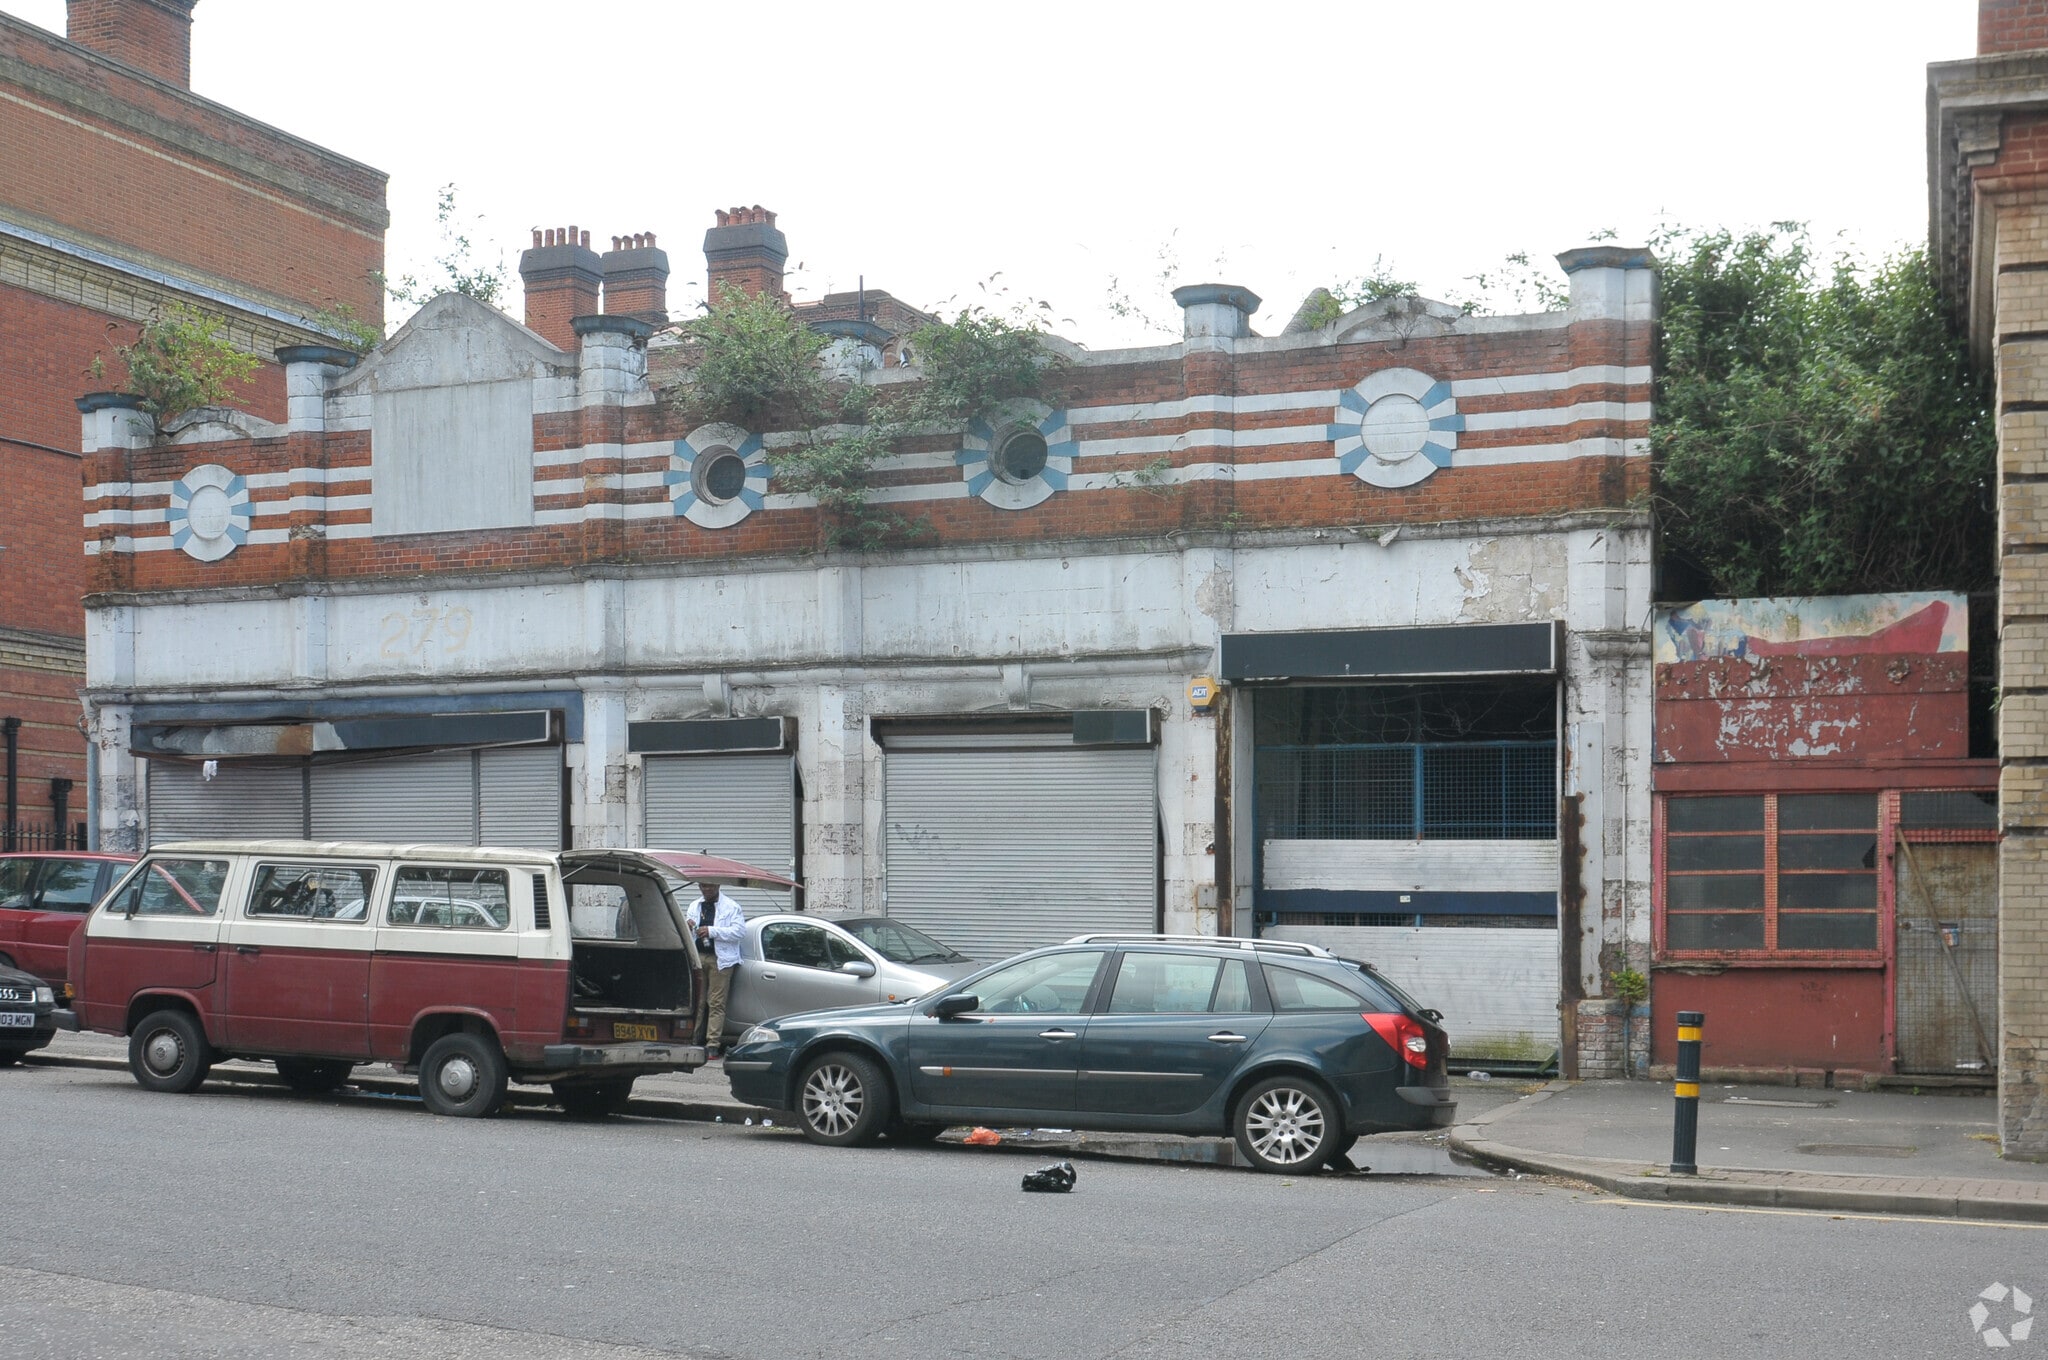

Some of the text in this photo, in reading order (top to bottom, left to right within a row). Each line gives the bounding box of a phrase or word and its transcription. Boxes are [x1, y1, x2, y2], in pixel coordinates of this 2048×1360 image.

[380, 606, 473, 659] 279
[1192, 688, 1207, 697] ADT
[0, 1014, 32, 1026] 03 MGN
